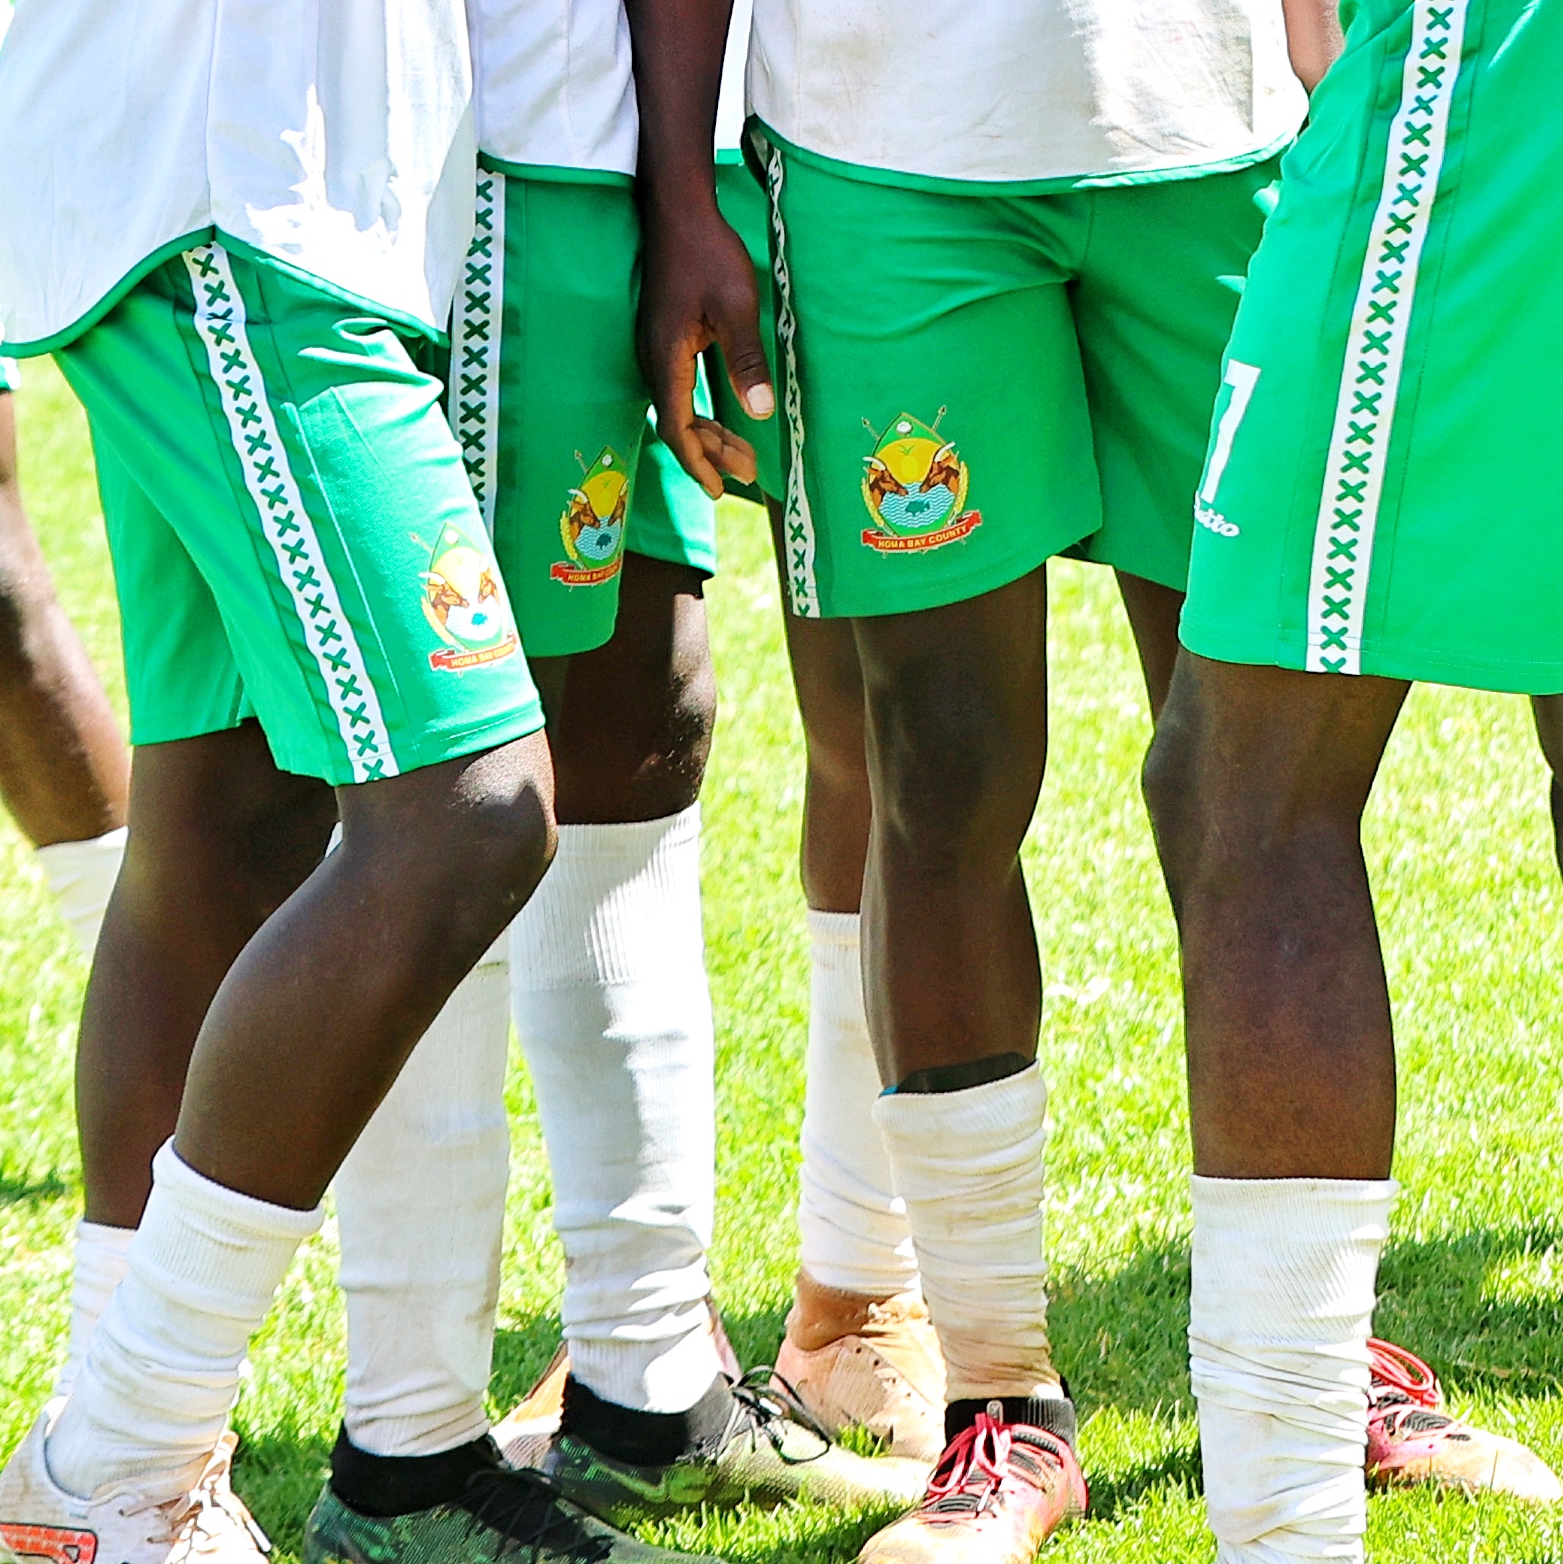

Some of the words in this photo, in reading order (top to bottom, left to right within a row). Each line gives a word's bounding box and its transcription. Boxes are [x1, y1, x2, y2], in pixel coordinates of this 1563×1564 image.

[878, 539, 906, 549] HOMA
[906, 537, 927, 548] BAY
[928, 524, 968, 544] COUNTY
